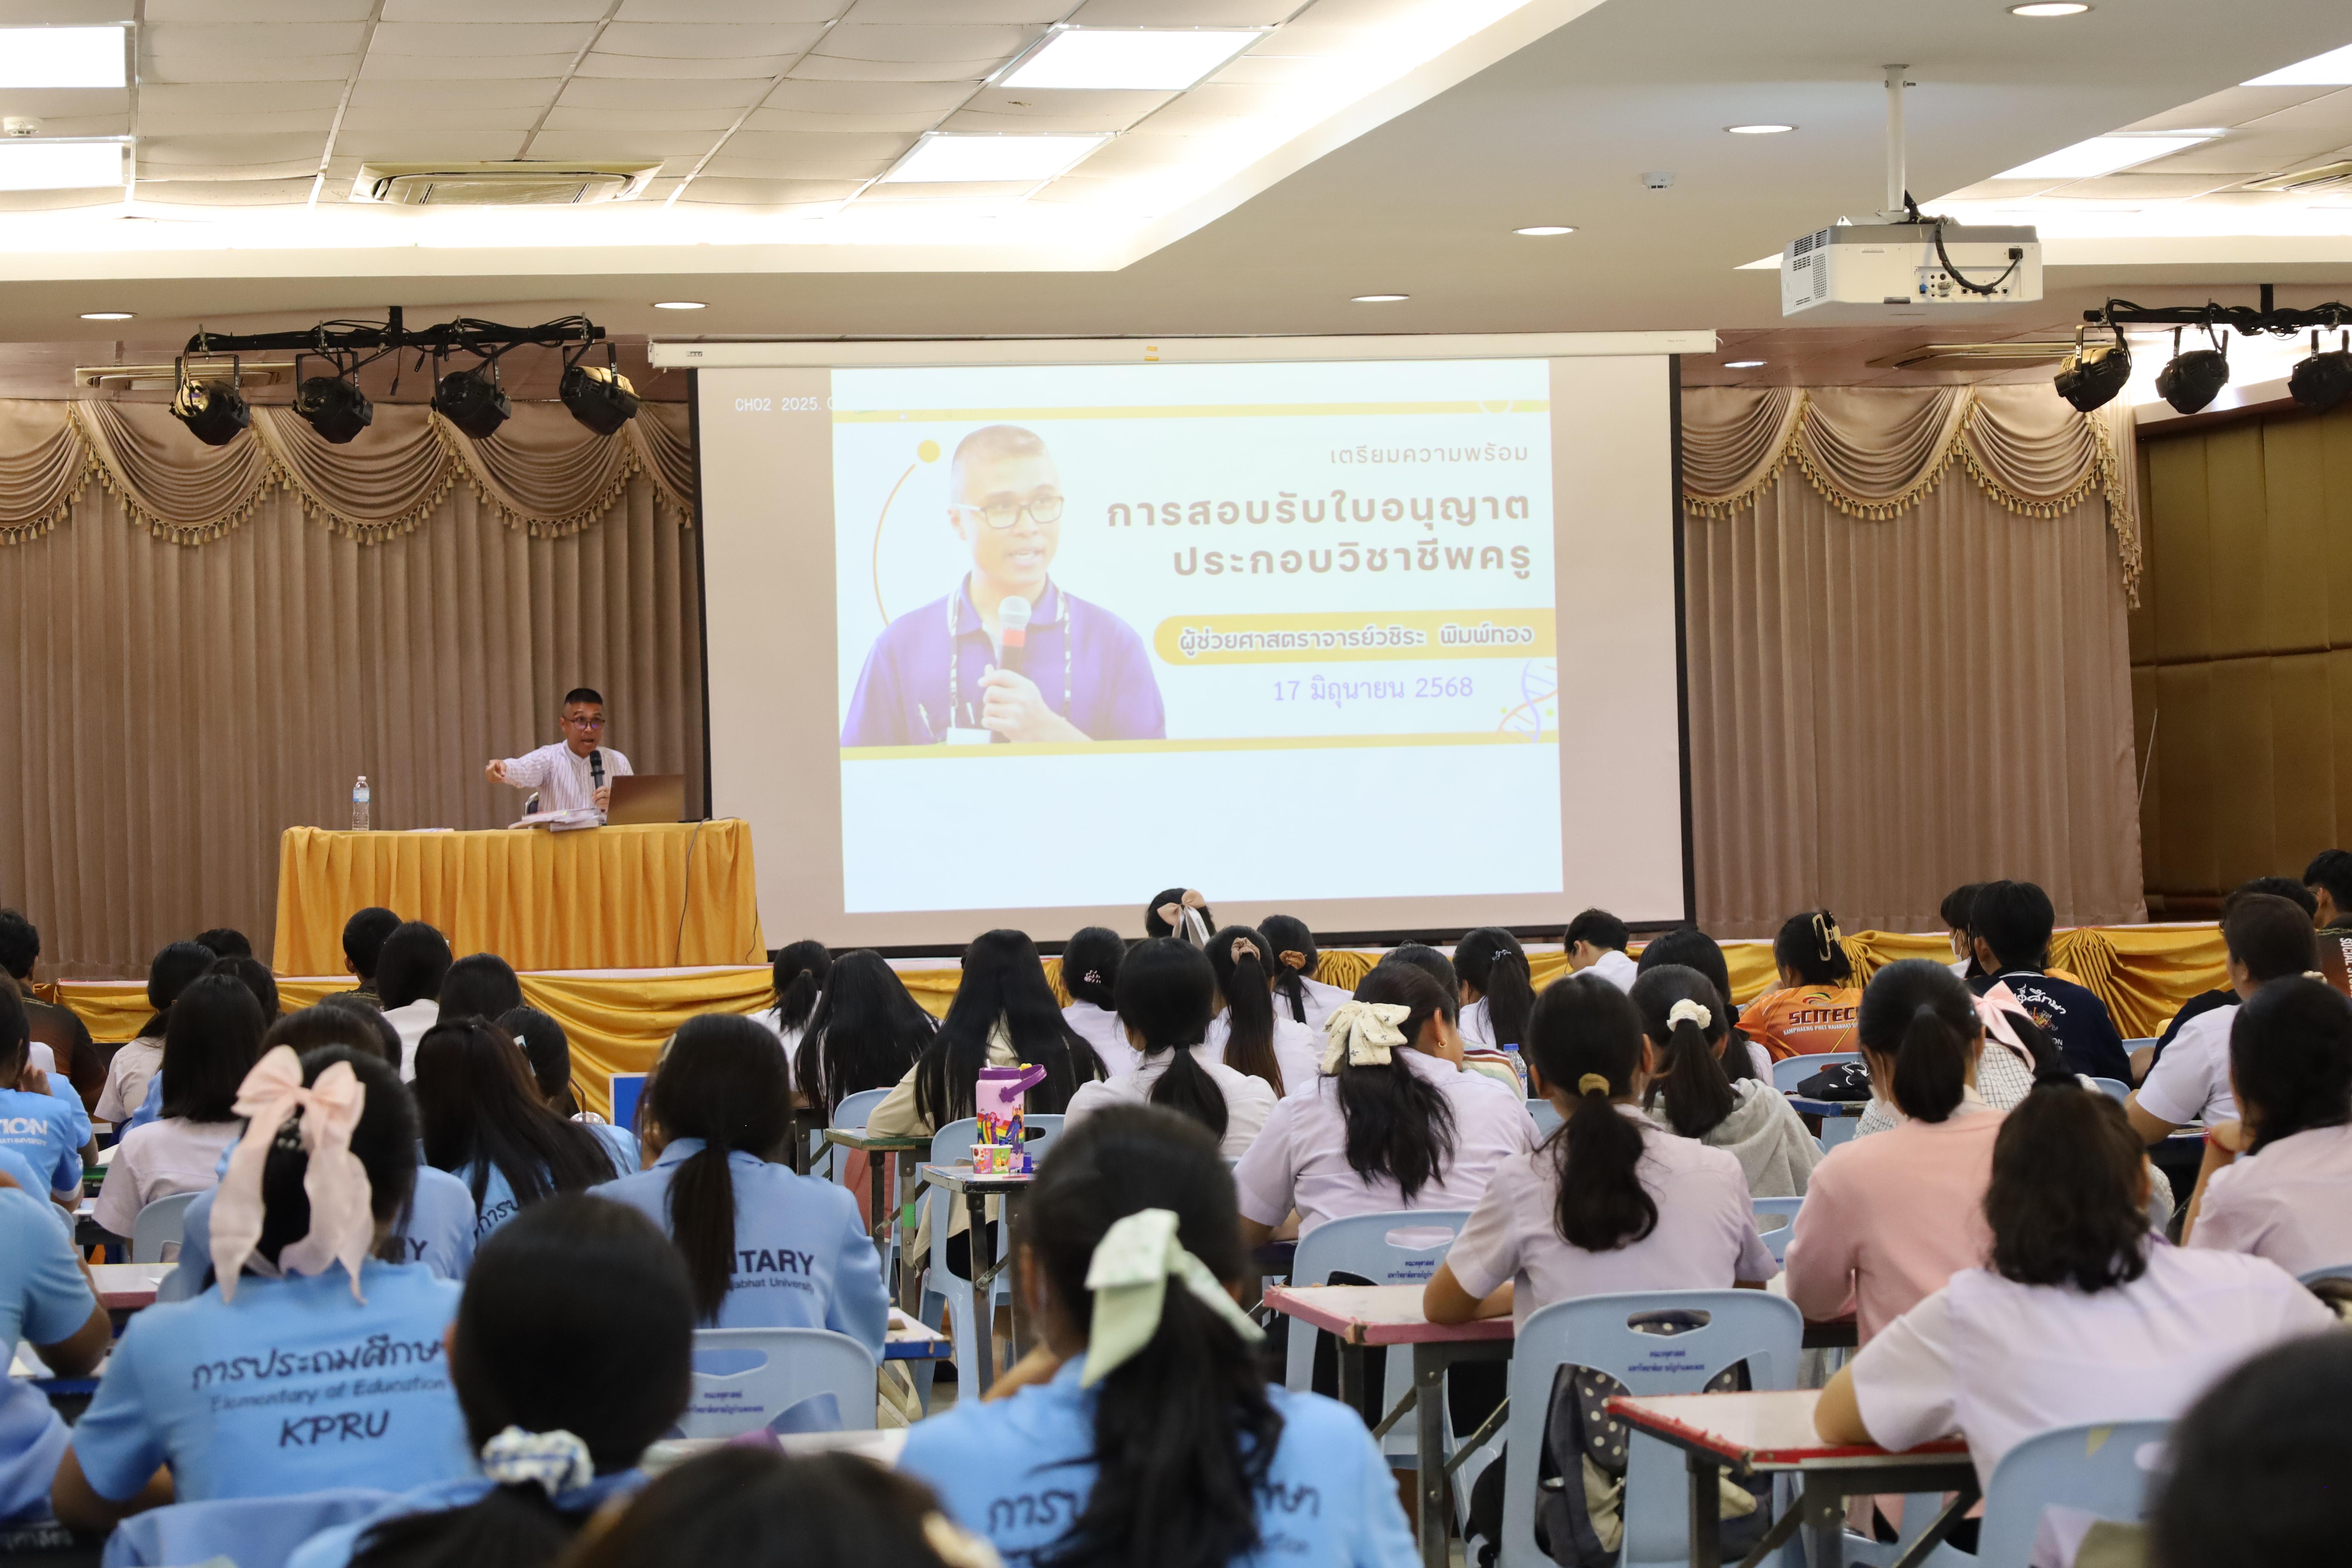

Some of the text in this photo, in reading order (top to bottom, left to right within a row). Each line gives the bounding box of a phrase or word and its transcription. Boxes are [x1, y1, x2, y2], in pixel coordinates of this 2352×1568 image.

[1331, 442, 1527, 464] เตรียมความพร้อม
[1107, 489, 1530, 530] การสอบรับใบอนุญาต
[1173, 538, 1531, 579] ประกอบวิชาชีพครู
[1179, 622, 1533, 657] ผู้ช่วยศาสตราจารย์วชิระ พิมพ์ทอง
[1274, 674, 1473, 709] 17 มิถุนายน 2568
[1783, 1026, 1813, 1036] KAMPHAENG
[1789, 1007, 1859, 1026] SCITEC
[279, 1410, 390, 1447] KPRU
